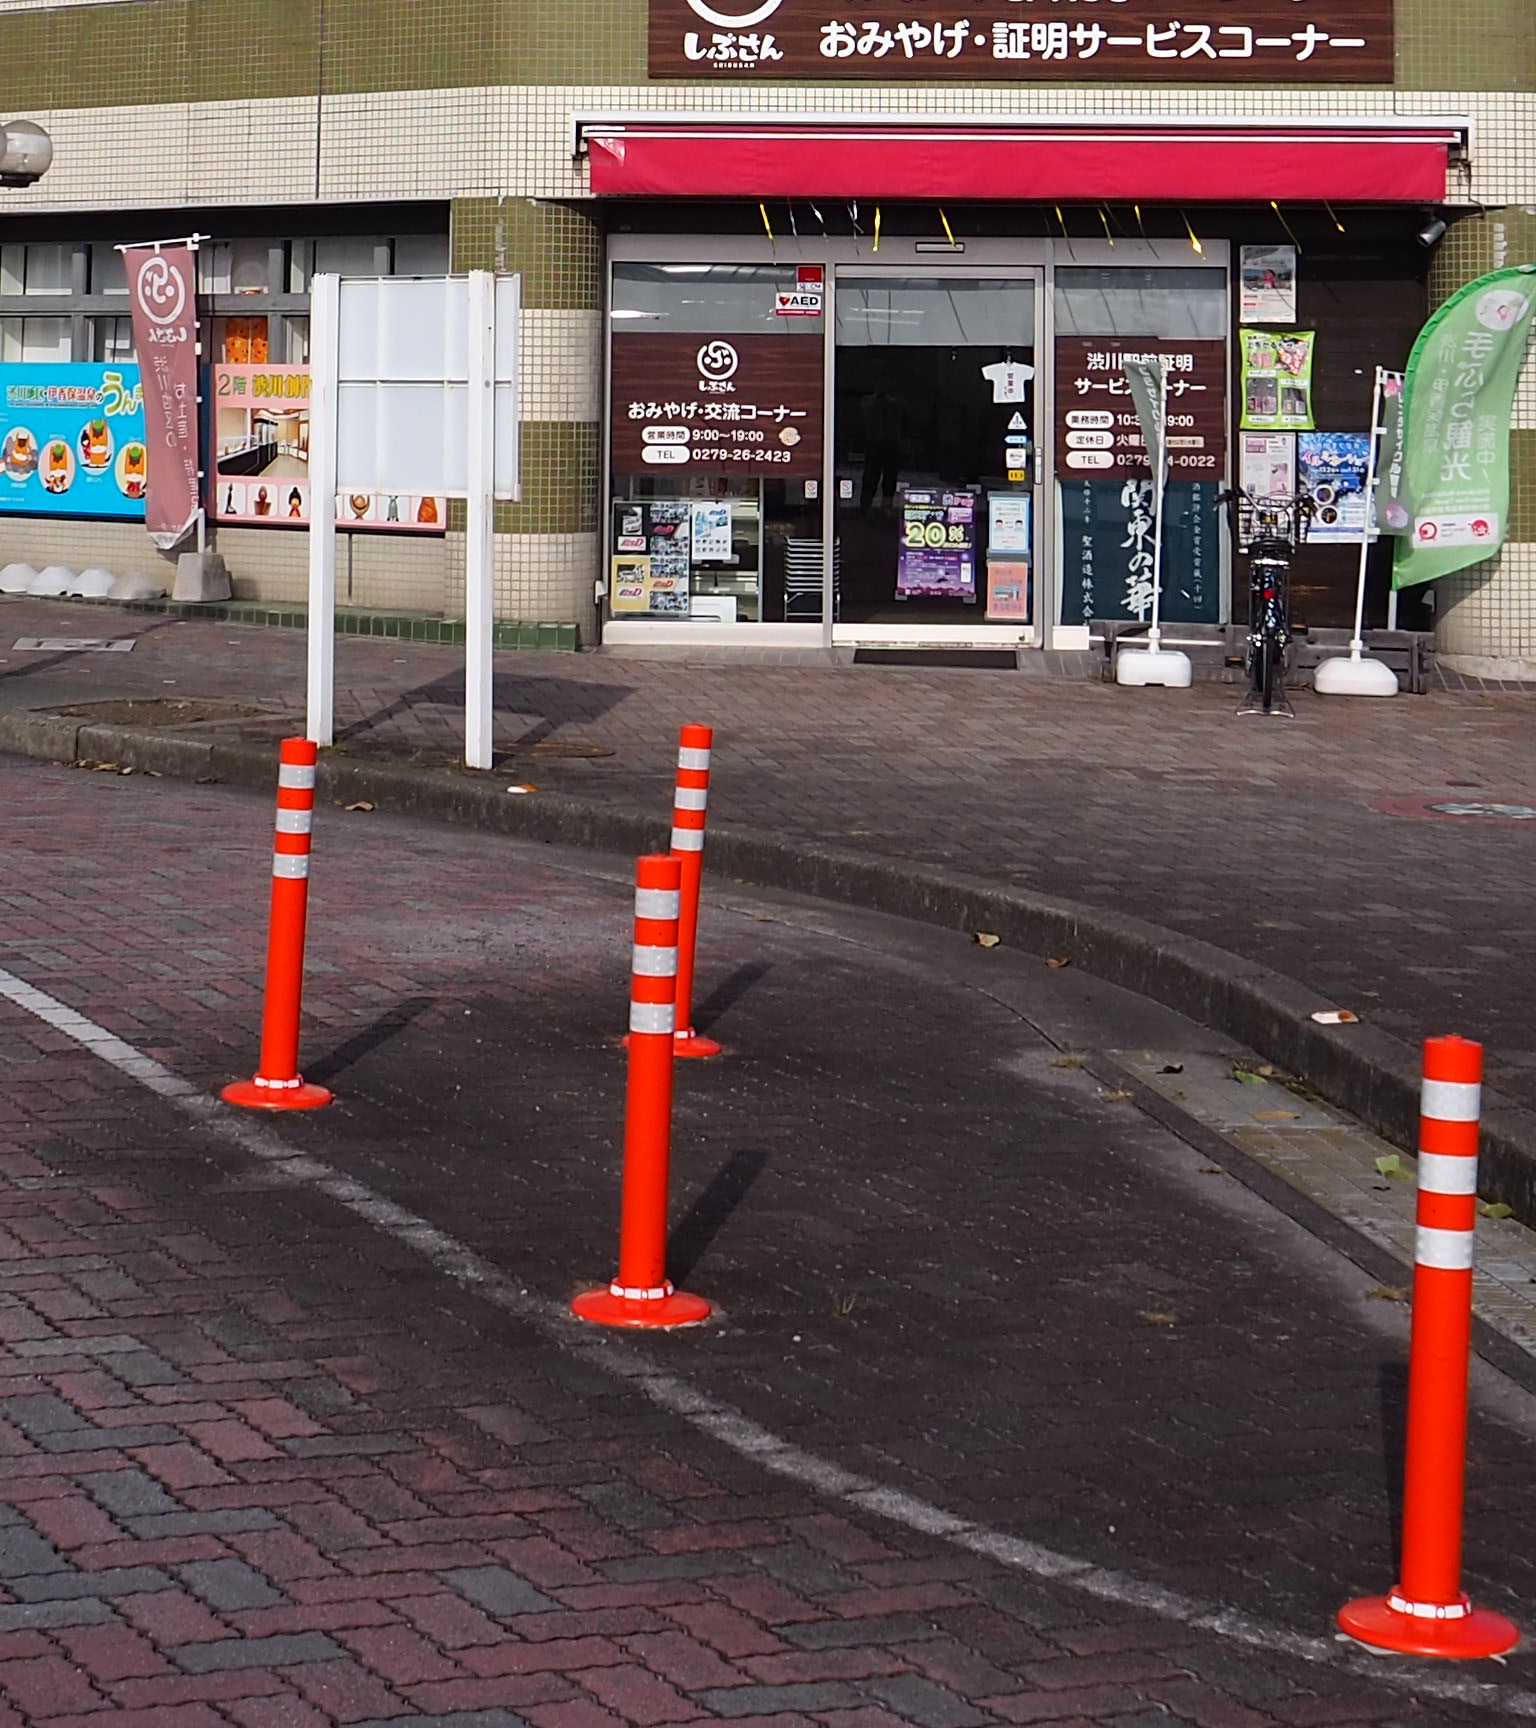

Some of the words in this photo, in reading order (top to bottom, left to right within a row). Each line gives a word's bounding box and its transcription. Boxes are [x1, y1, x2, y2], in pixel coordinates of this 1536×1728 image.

[684, 32, 784, 62] しぶさん
[819, 20, 1365, 62] おみやげ・証明サービスコーナー
[790, 296, 819, 306] AED
[218, 373, 247, 397] 2階
[627, 401, 807, 423] おみやげ・交流コーナー
[646, 429, 686, 441] 営業時間
[1076, 435, 1105, 445] 定休日
[656, 450, 676, 460] TEL
[692, 448, 792, 463] 0279-26-2423
[1080, 455, 1100, 465] TEL
[1116, 454, 1216, 468] 02794-0022
